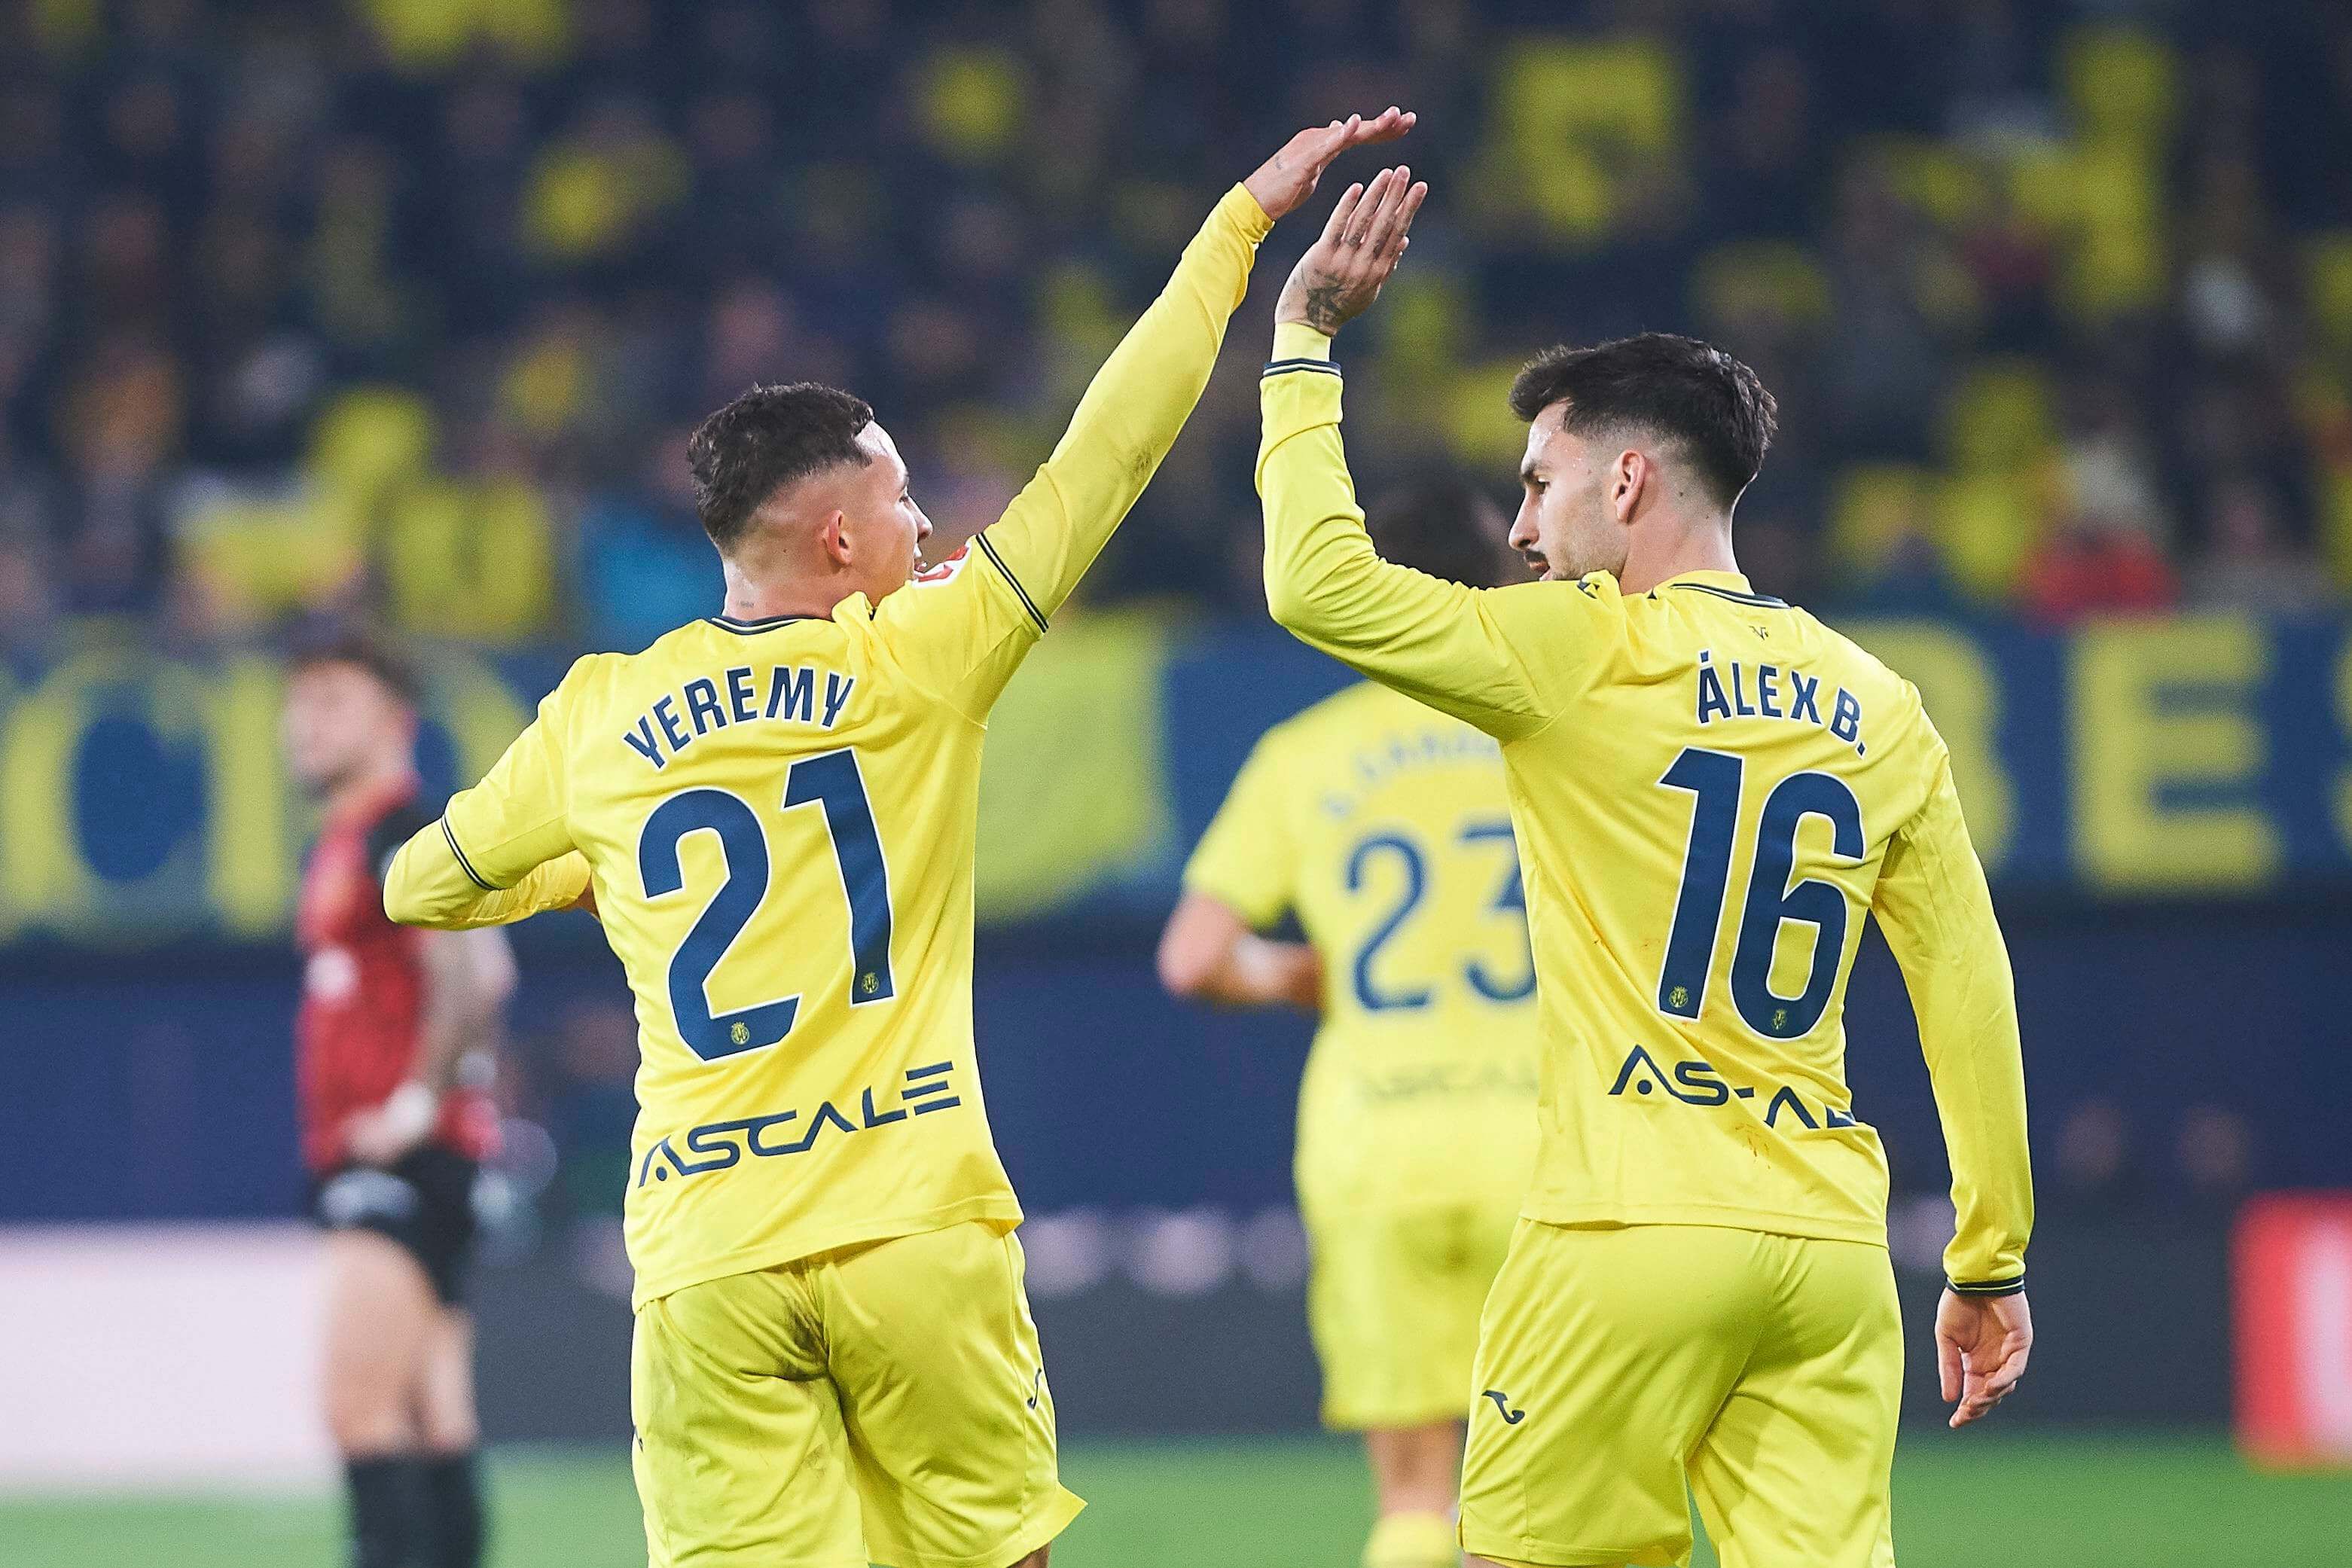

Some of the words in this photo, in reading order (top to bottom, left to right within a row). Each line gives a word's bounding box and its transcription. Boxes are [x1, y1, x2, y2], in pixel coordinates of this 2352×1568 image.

[622, 665, 856, 770] YEREMY
[637, 747, 895, 1063] 21
[1344, 817, 1538, 1013] 23
[1657, 746, 1865, 1041] 16
[637, 1060, 962, 1189] ASCALE
